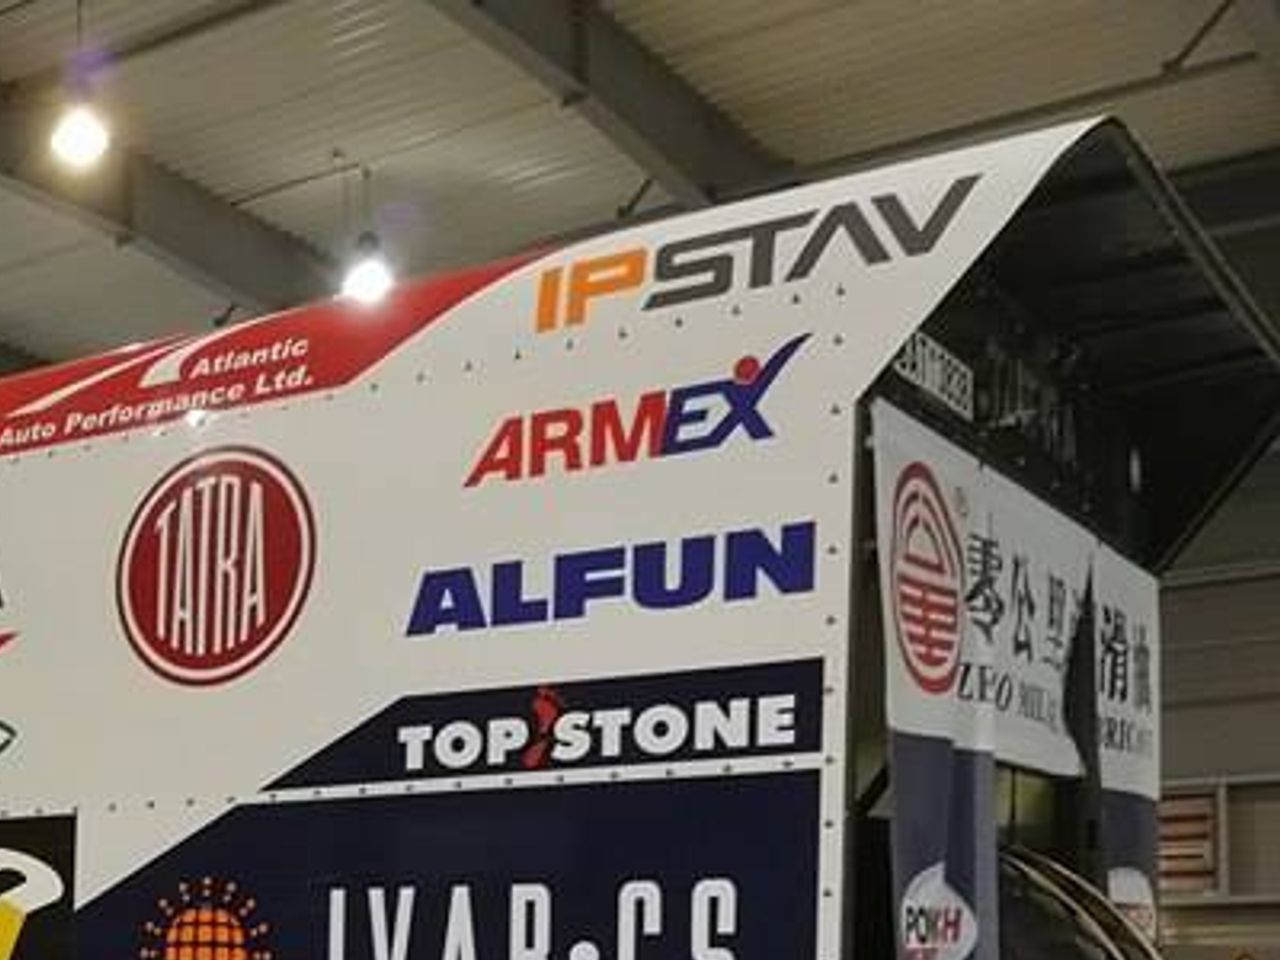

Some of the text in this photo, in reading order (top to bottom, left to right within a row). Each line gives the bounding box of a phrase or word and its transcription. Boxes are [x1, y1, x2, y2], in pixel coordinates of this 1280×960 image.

[534, 173, 984, 333] IPSTAV
[64, 385, 245, 434] Performance
[255, 366, 314, 394] Ltd.
[189, 338, 309, 378] Atlantic
[463, 333, 813, 487] ARMEX
[154, 474, 266, 657] TATRA
[405, 521, 816, 637] ALFUN
[398, 694, 797, 770] TOP STONE
